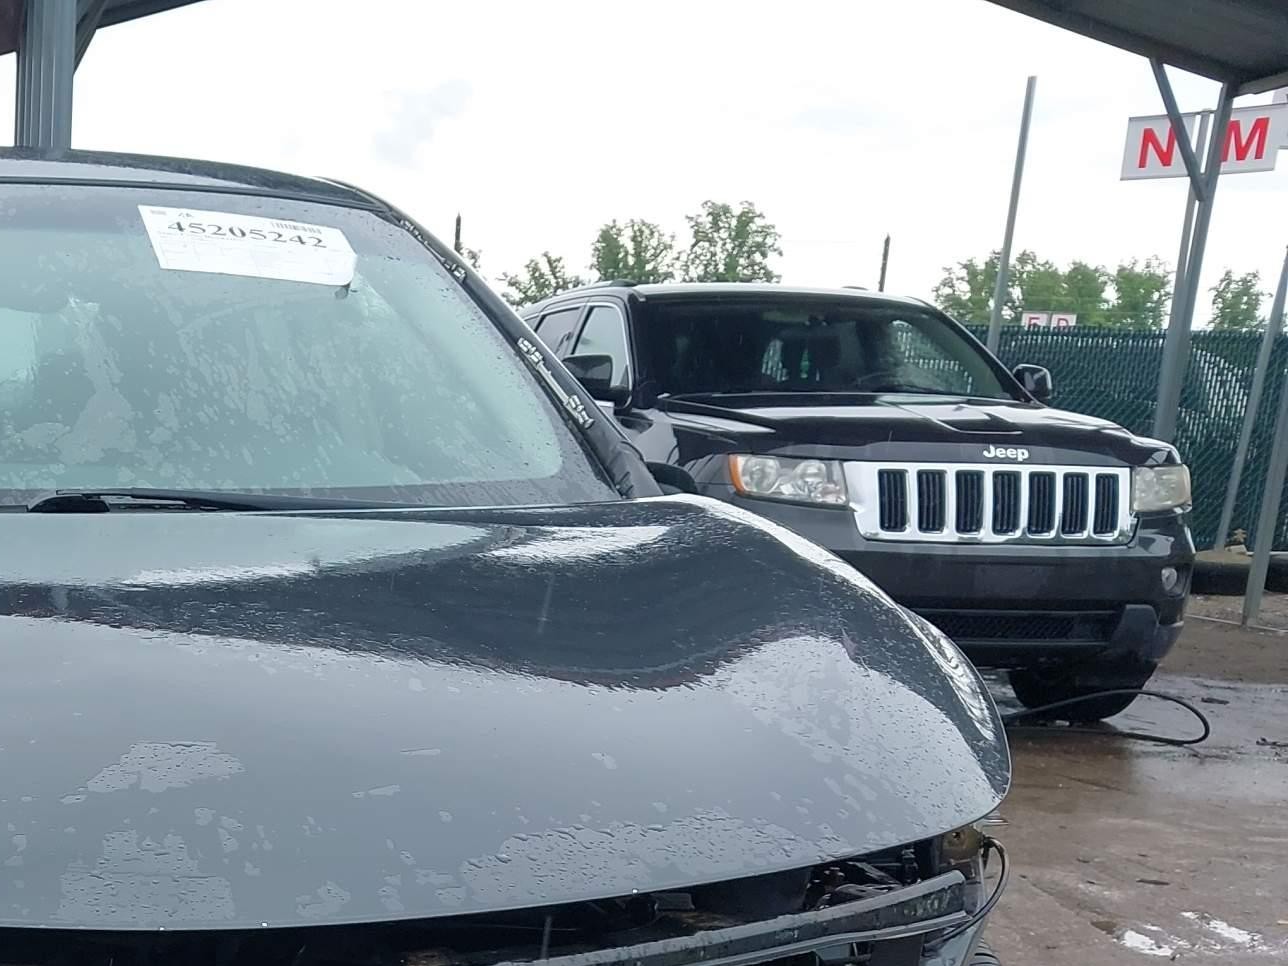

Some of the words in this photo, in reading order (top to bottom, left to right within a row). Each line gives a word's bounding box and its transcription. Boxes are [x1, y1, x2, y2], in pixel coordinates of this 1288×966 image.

[1138, 127, 1176, 168] N
[1221, 117, 1270, 162] M
[167, 220, 328, 249] 45205242
[982, 444, 1030, 462] Jeep
